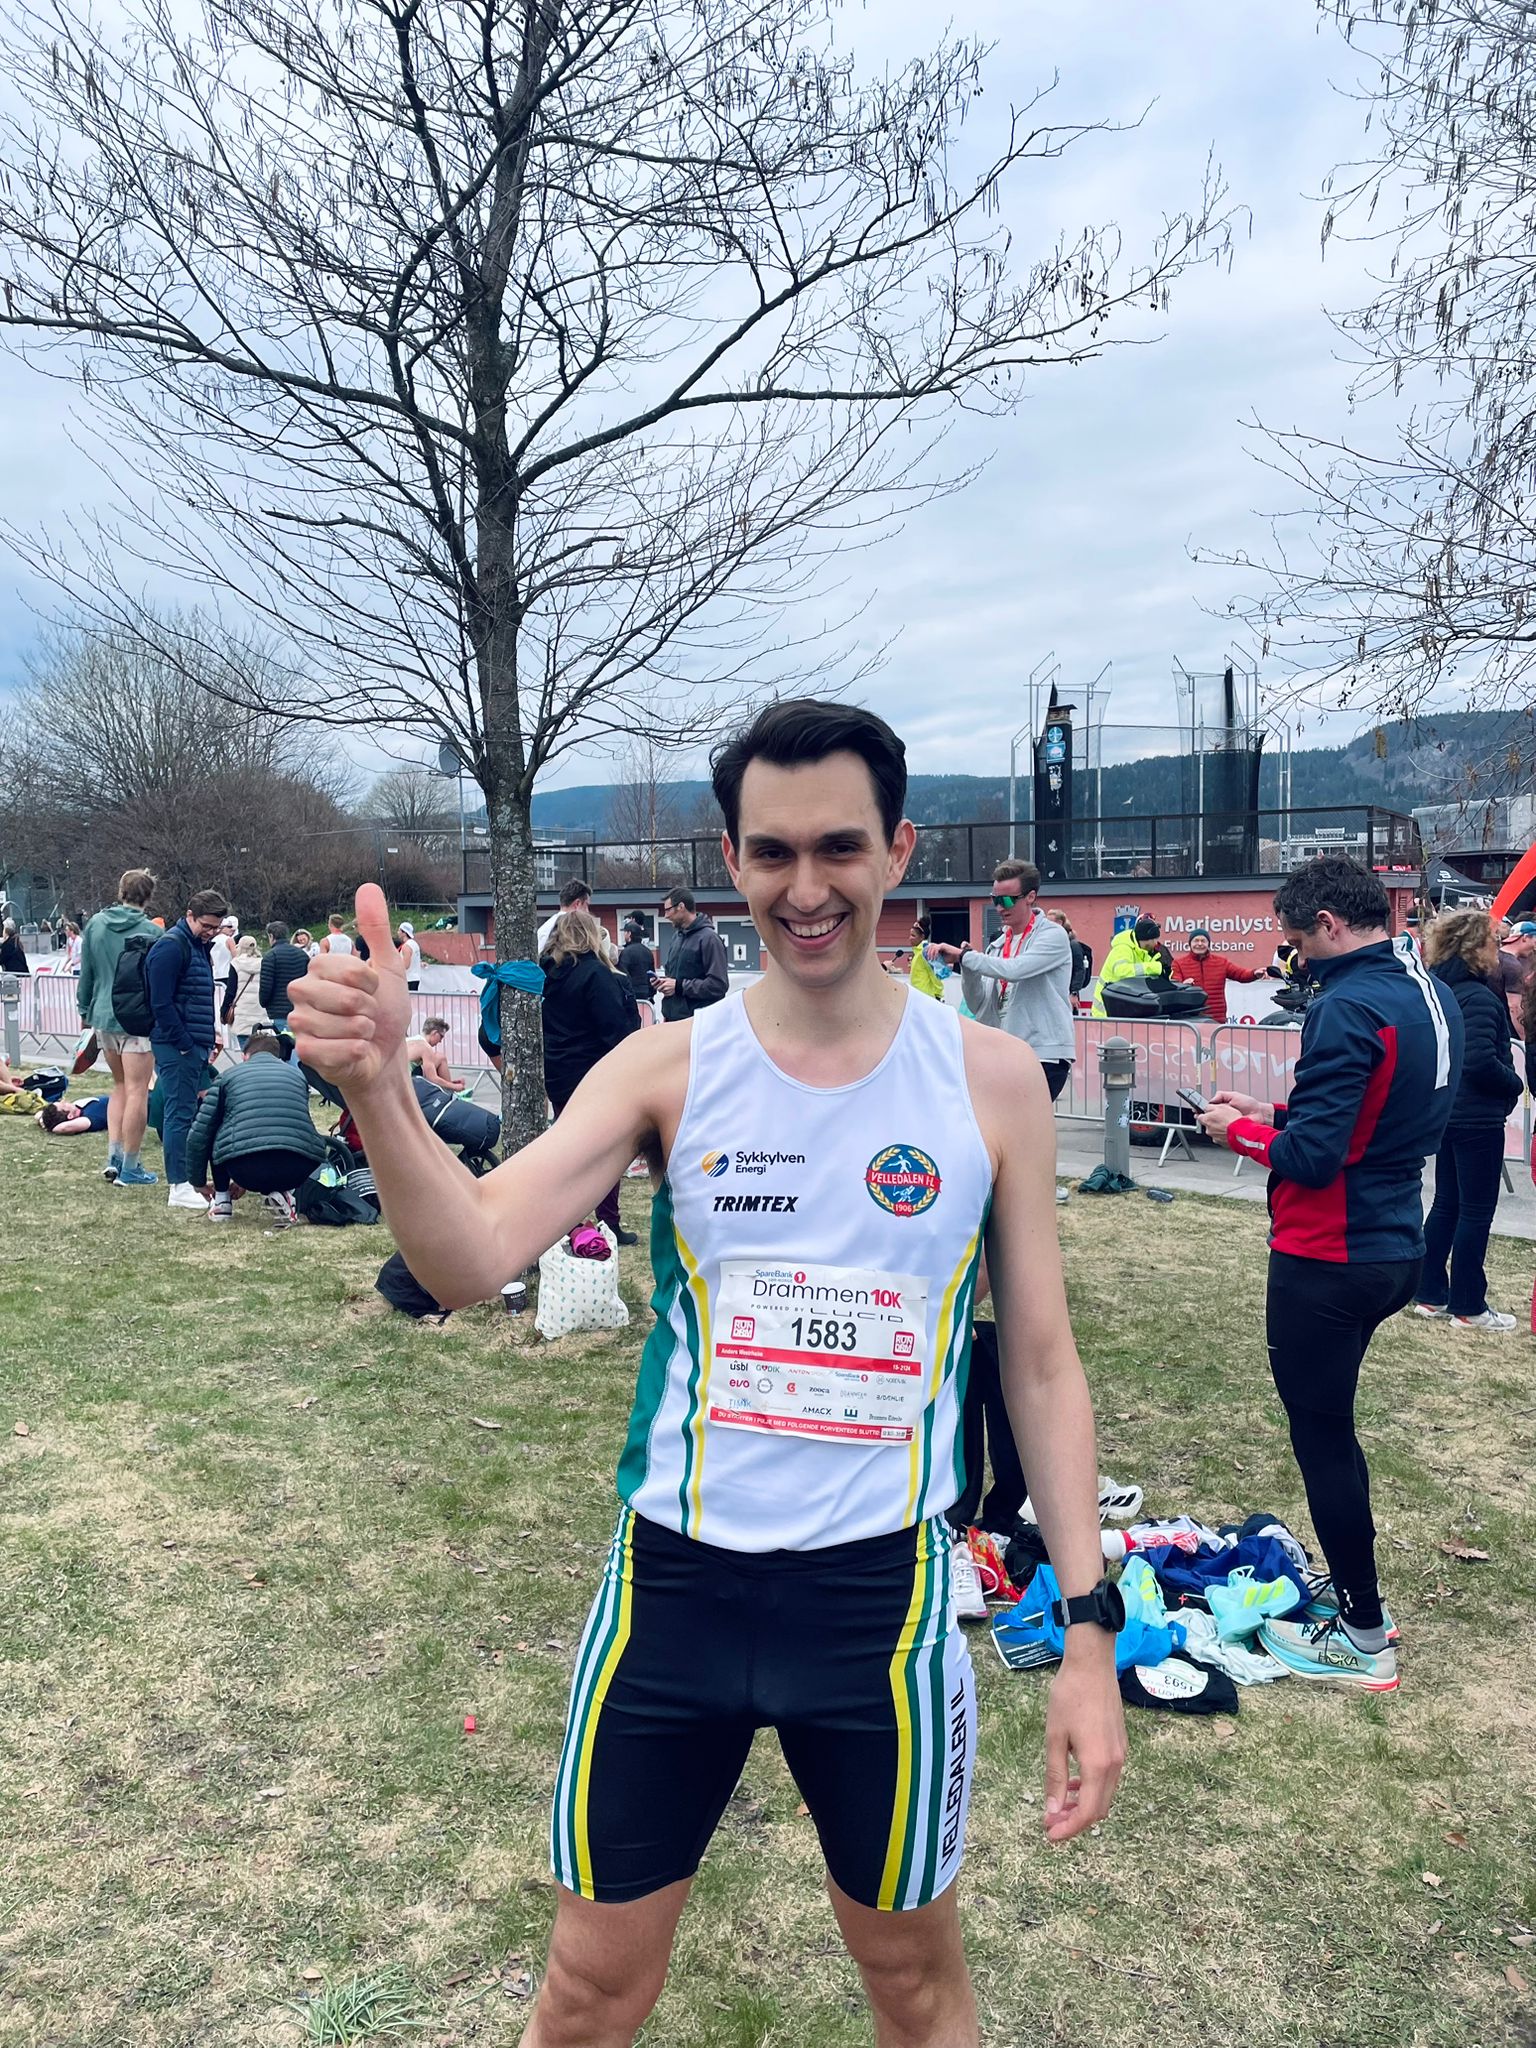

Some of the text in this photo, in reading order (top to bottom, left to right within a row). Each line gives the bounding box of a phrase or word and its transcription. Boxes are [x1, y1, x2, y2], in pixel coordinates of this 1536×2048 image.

[1164, 915, 1273, 936] Marienlyst
[1163, 939, 1255, 952] Friidtsbane
[736, 1151, 805, 1166] Sykkylven
[736, 1164, 767, 1175] Energi
[871, 1172, 924, 1185] VELLEDALEN
[713, 1195, 799, 1212] TRIMTEX
[895, 1204, 912, 1213] 1906
[755, 1269, 793, 1278] SpareBank
[791, 1317, 857, 1351] 1583
[802, 1406, 832, 1415] AMACX
[1318, 1651, 1359, 1667] HOKA
[940, 1678, 967, 1871] VELLEDALEN IL
